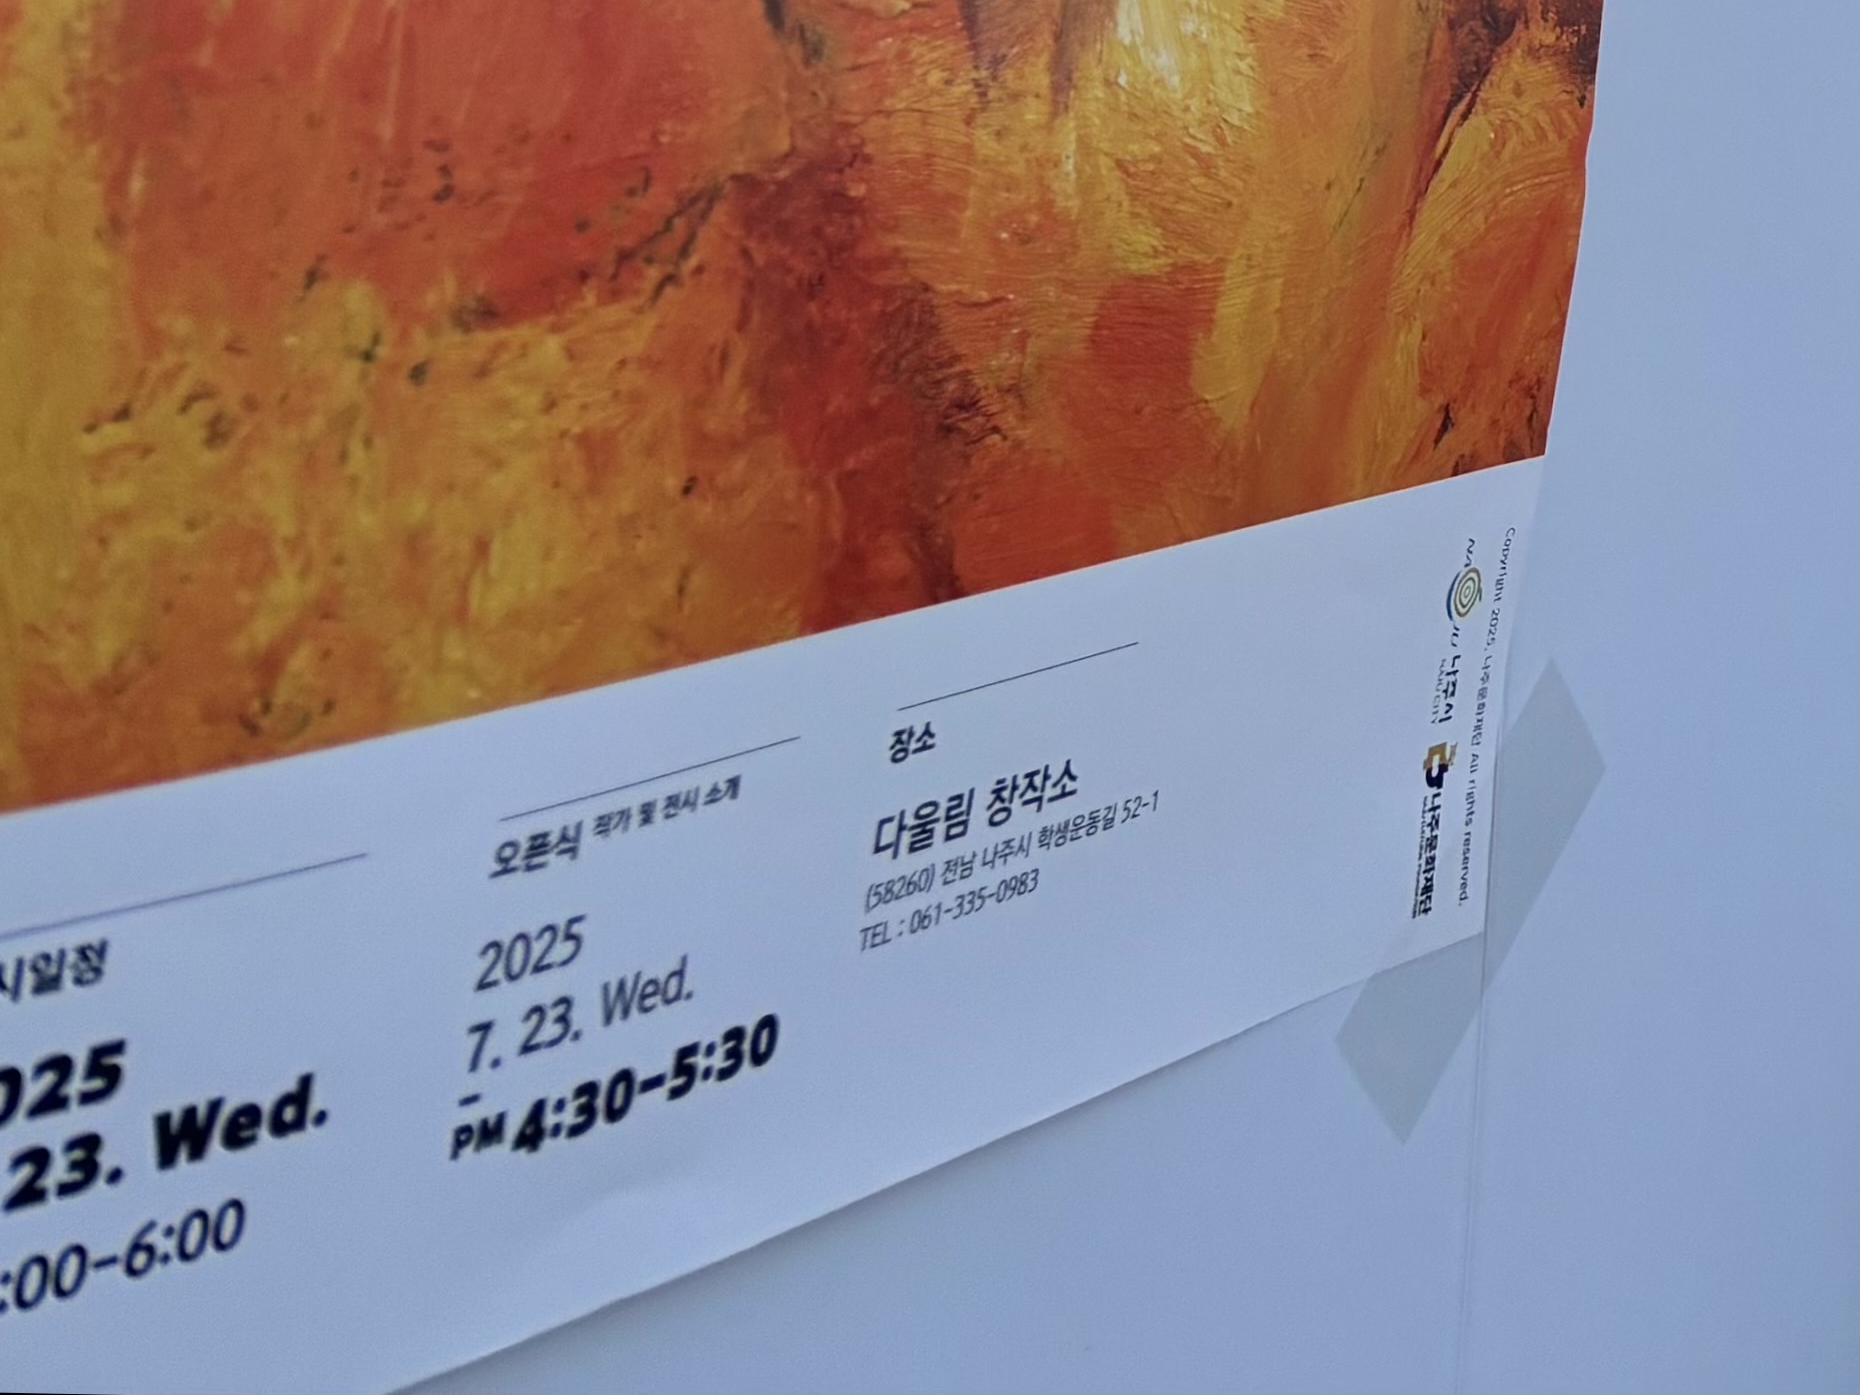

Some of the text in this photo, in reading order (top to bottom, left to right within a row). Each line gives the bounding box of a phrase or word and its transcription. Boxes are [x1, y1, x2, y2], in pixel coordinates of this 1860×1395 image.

[1438, 654, 1461, 723] 나주시
[889, 721, 936, 764] 장소
[488, 820, 582, 879] 오픈식
[593, 807, 632, 839] 작가
[663, 785, 701, 819] 전시
[703, 774, 742, 807] 소개
[872, 758, 1078, 860] 다울림 창작소
[941, 849, 977, 886] 전남
[981, 831, 1032, 870] 나주시
[1037, 802, 1118, 851] 학생운동길
[1120, 789, 1160, 825] 52-1
[474, 914, 587, 992] 2025
[859, 922, 893, 952] TEL
[910, 868, 1040, 935] 061-335-0983
[467, 954, 694, 1073] 7. 23. Wed.
[153, 1072, 329, 1172] Wed.
[449, 1112, 505, 1161] PM
